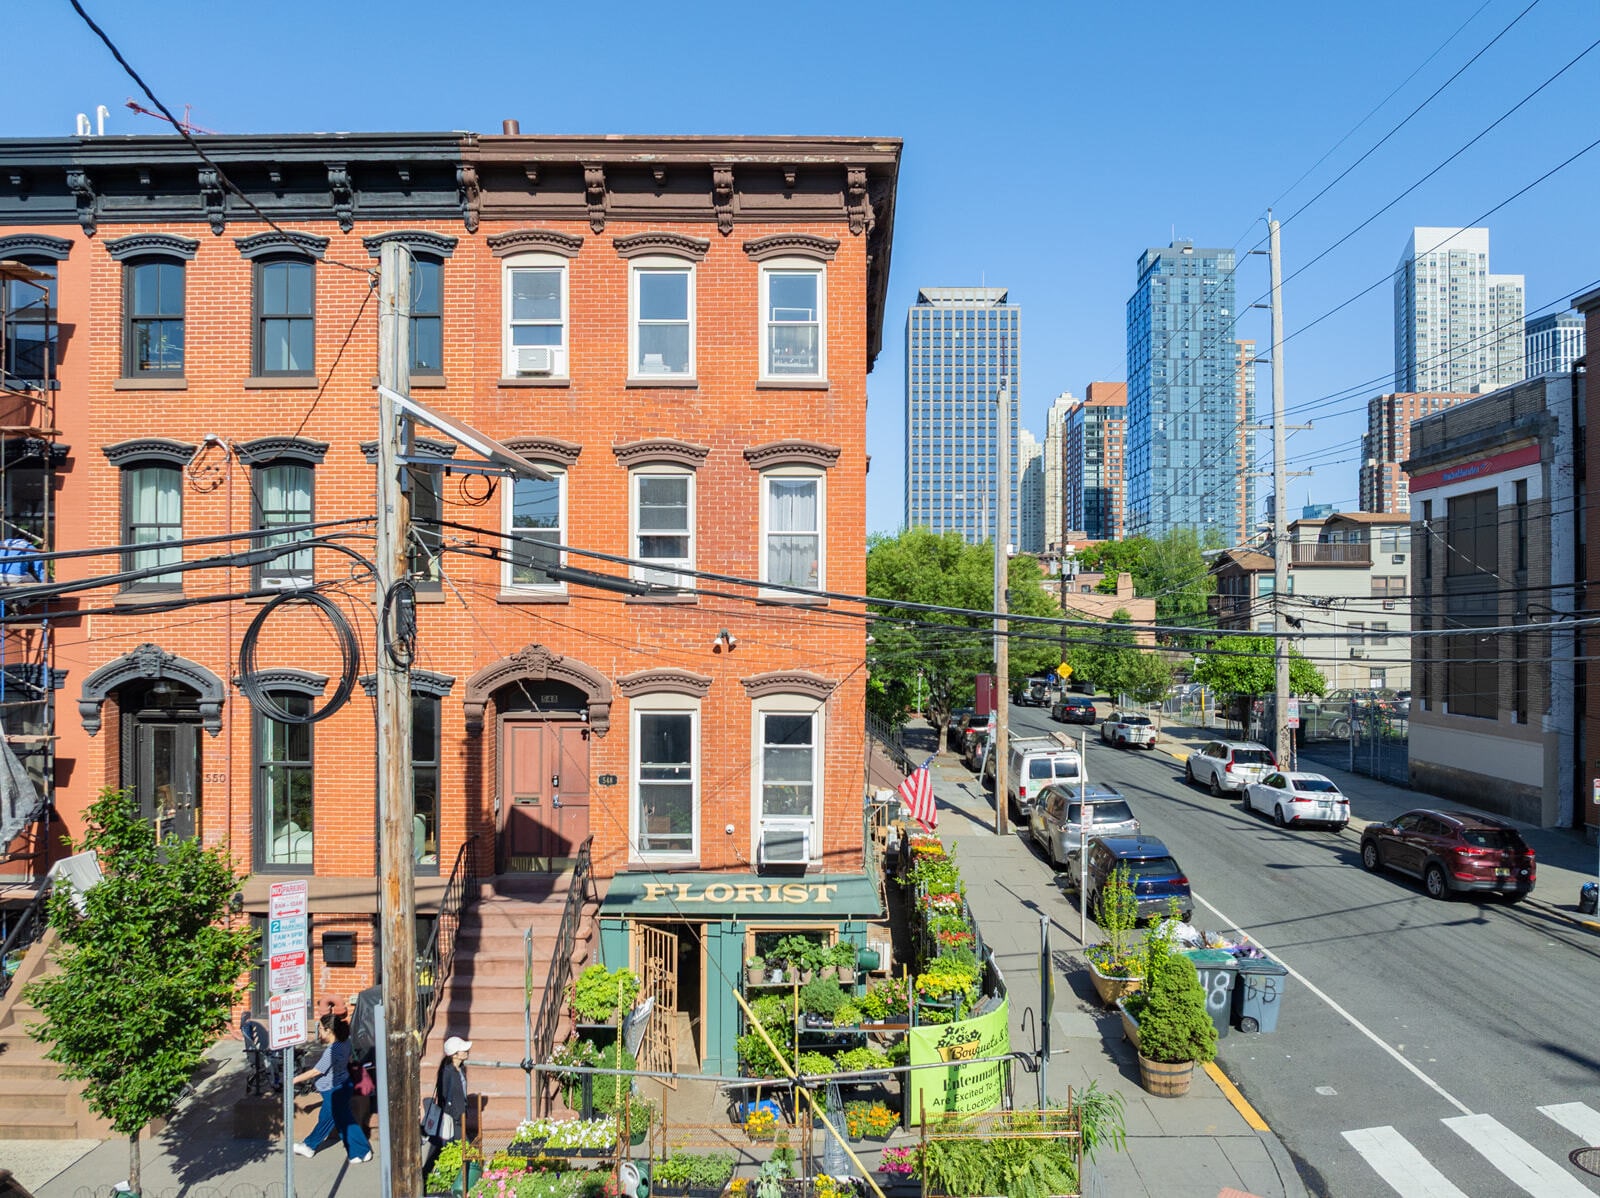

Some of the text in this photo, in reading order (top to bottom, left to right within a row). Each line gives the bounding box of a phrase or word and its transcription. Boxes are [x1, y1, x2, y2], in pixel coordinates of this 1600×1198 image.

[205, 773, 226, 783] 550
[272, 884, 305, 895] NO PARKING
[642, 882, 838, 904] FLORIST
[272, 921, 280, 932] 2
[280, 960, 297, 968] ZONE
[281, 997, 304, 1007] PARKING
[280, 1011, 296, 1023] ANY
[279, 1023, 299, 1034] TIME
[951, 1033, 998, 1060] Bouquets
[932, 1096, 951, 1107] Are
[954, 1086, 987, 1103] Excited
